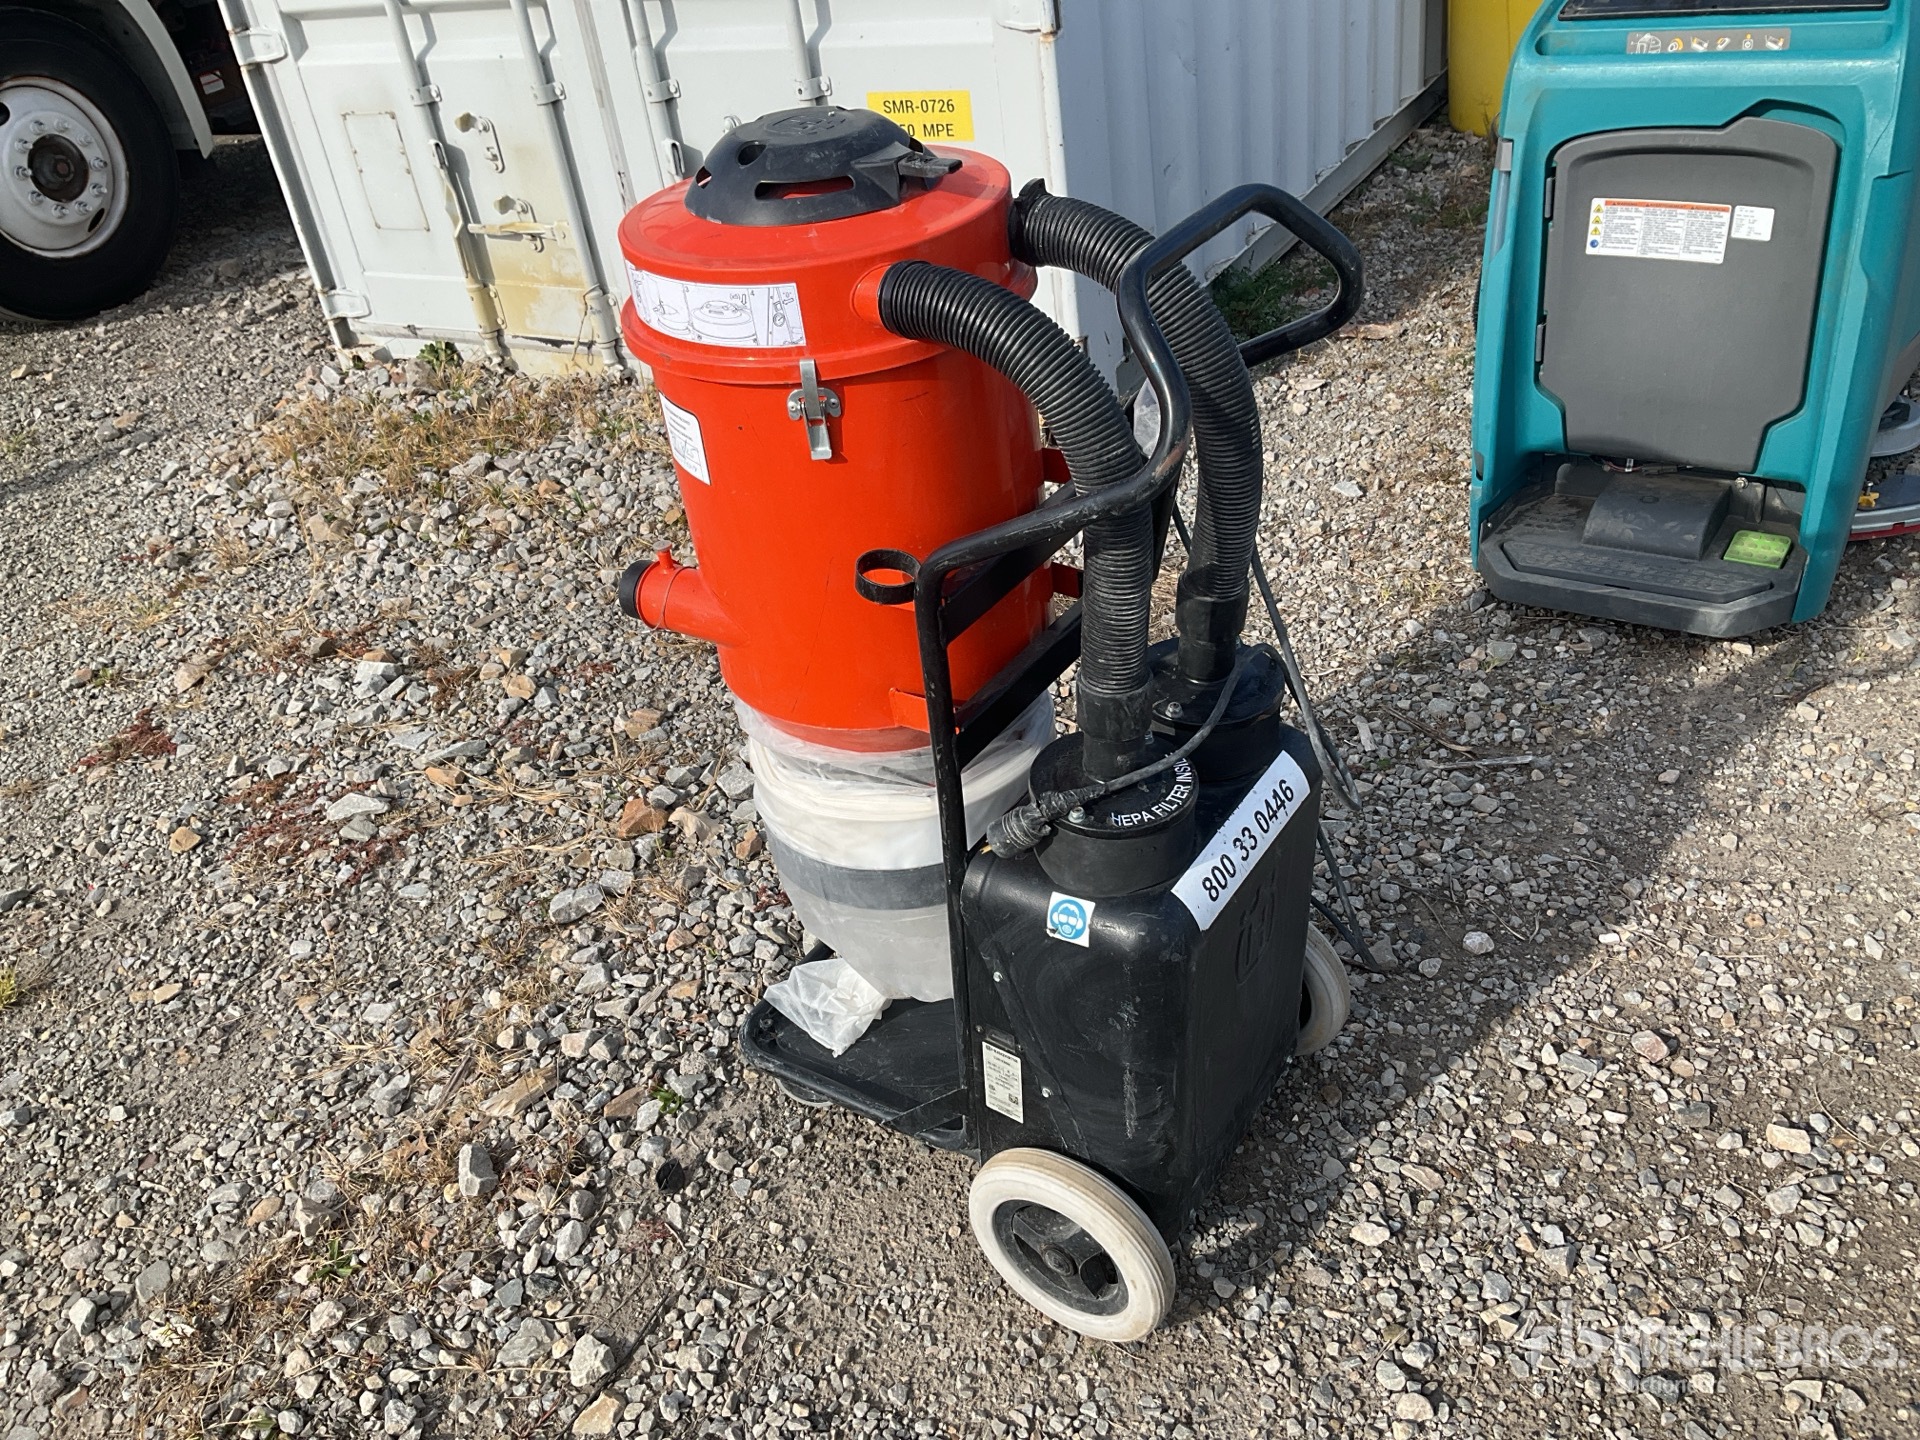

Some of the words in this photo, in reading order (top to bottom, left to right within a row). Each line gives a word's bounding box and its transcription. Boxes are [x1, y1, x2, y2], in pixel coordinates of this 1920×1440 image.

[882, 99, 955, 114] SMR-0726
[923, 124, 955, 137] MPE
[1169, 755, 1192, 782] INSI
[1151, 784, 1191, 817] FILTER
[1111, 811, 1155, 826] HEPA
[1202, 853, 1237, 901] 800
[1233, 826, 1258, 862] 33
[1254, 779, 1294, 834] 0446
